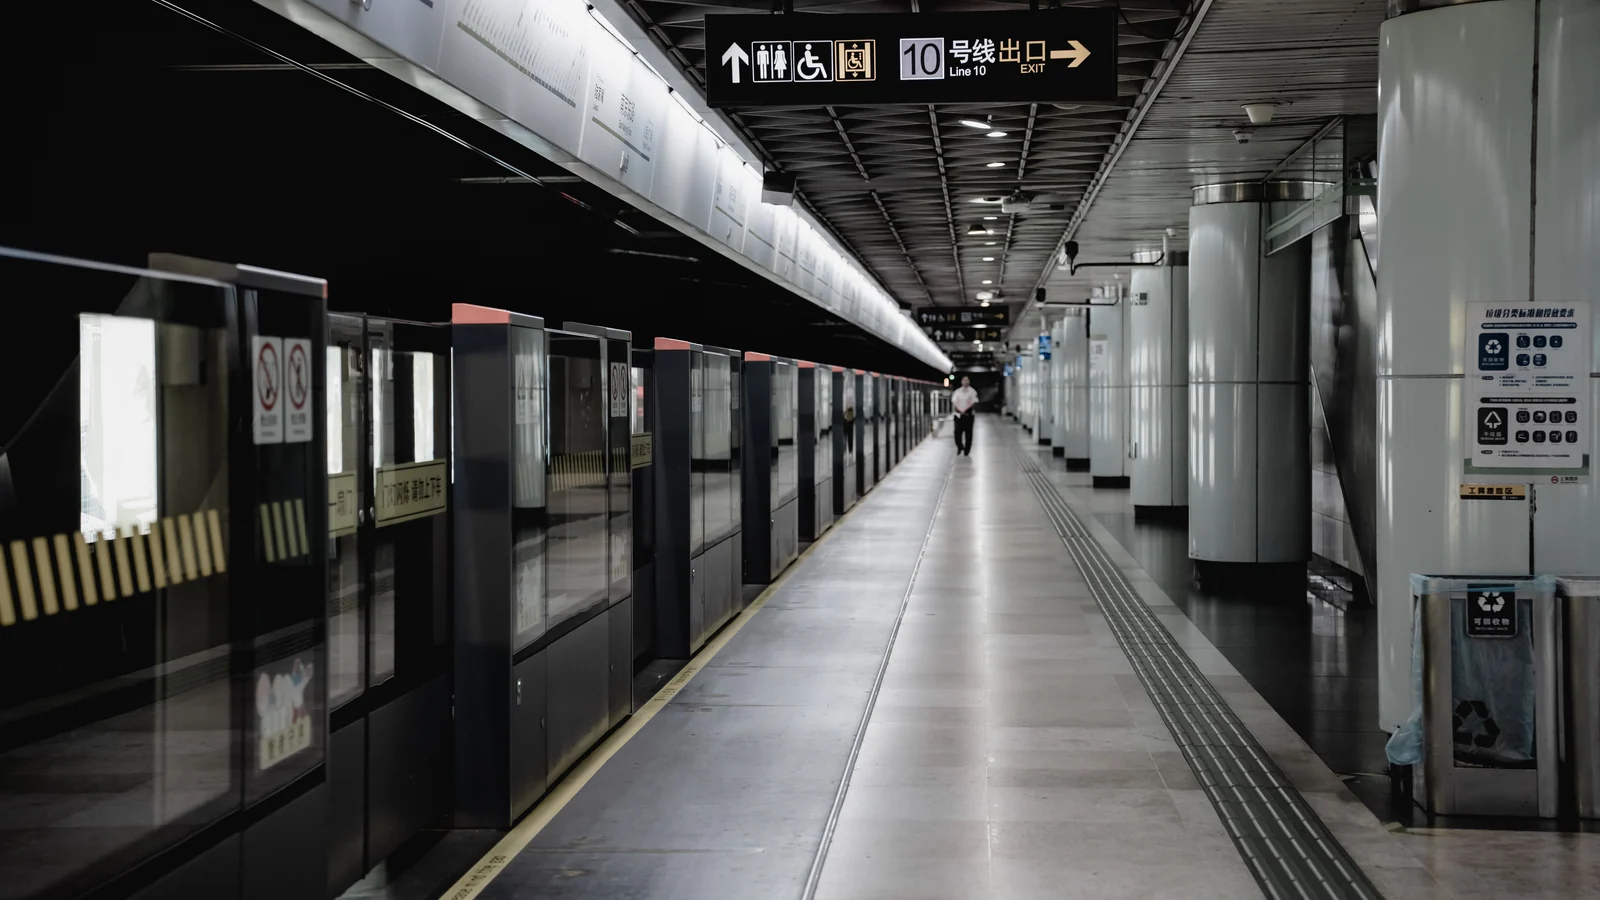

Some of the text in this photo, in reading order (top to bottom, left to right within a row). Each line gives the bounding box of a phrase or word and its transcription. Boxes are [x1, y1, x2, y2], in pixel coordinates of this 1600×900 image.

[903, 38, 996, 76] 10 号线
[999, 38, 1046, 64] 出口
[949, 65, 987, 77] Line 10
[1020, 63, 1046, 74] EXIT
[1473, 618, 1510, 626] 可回收物
